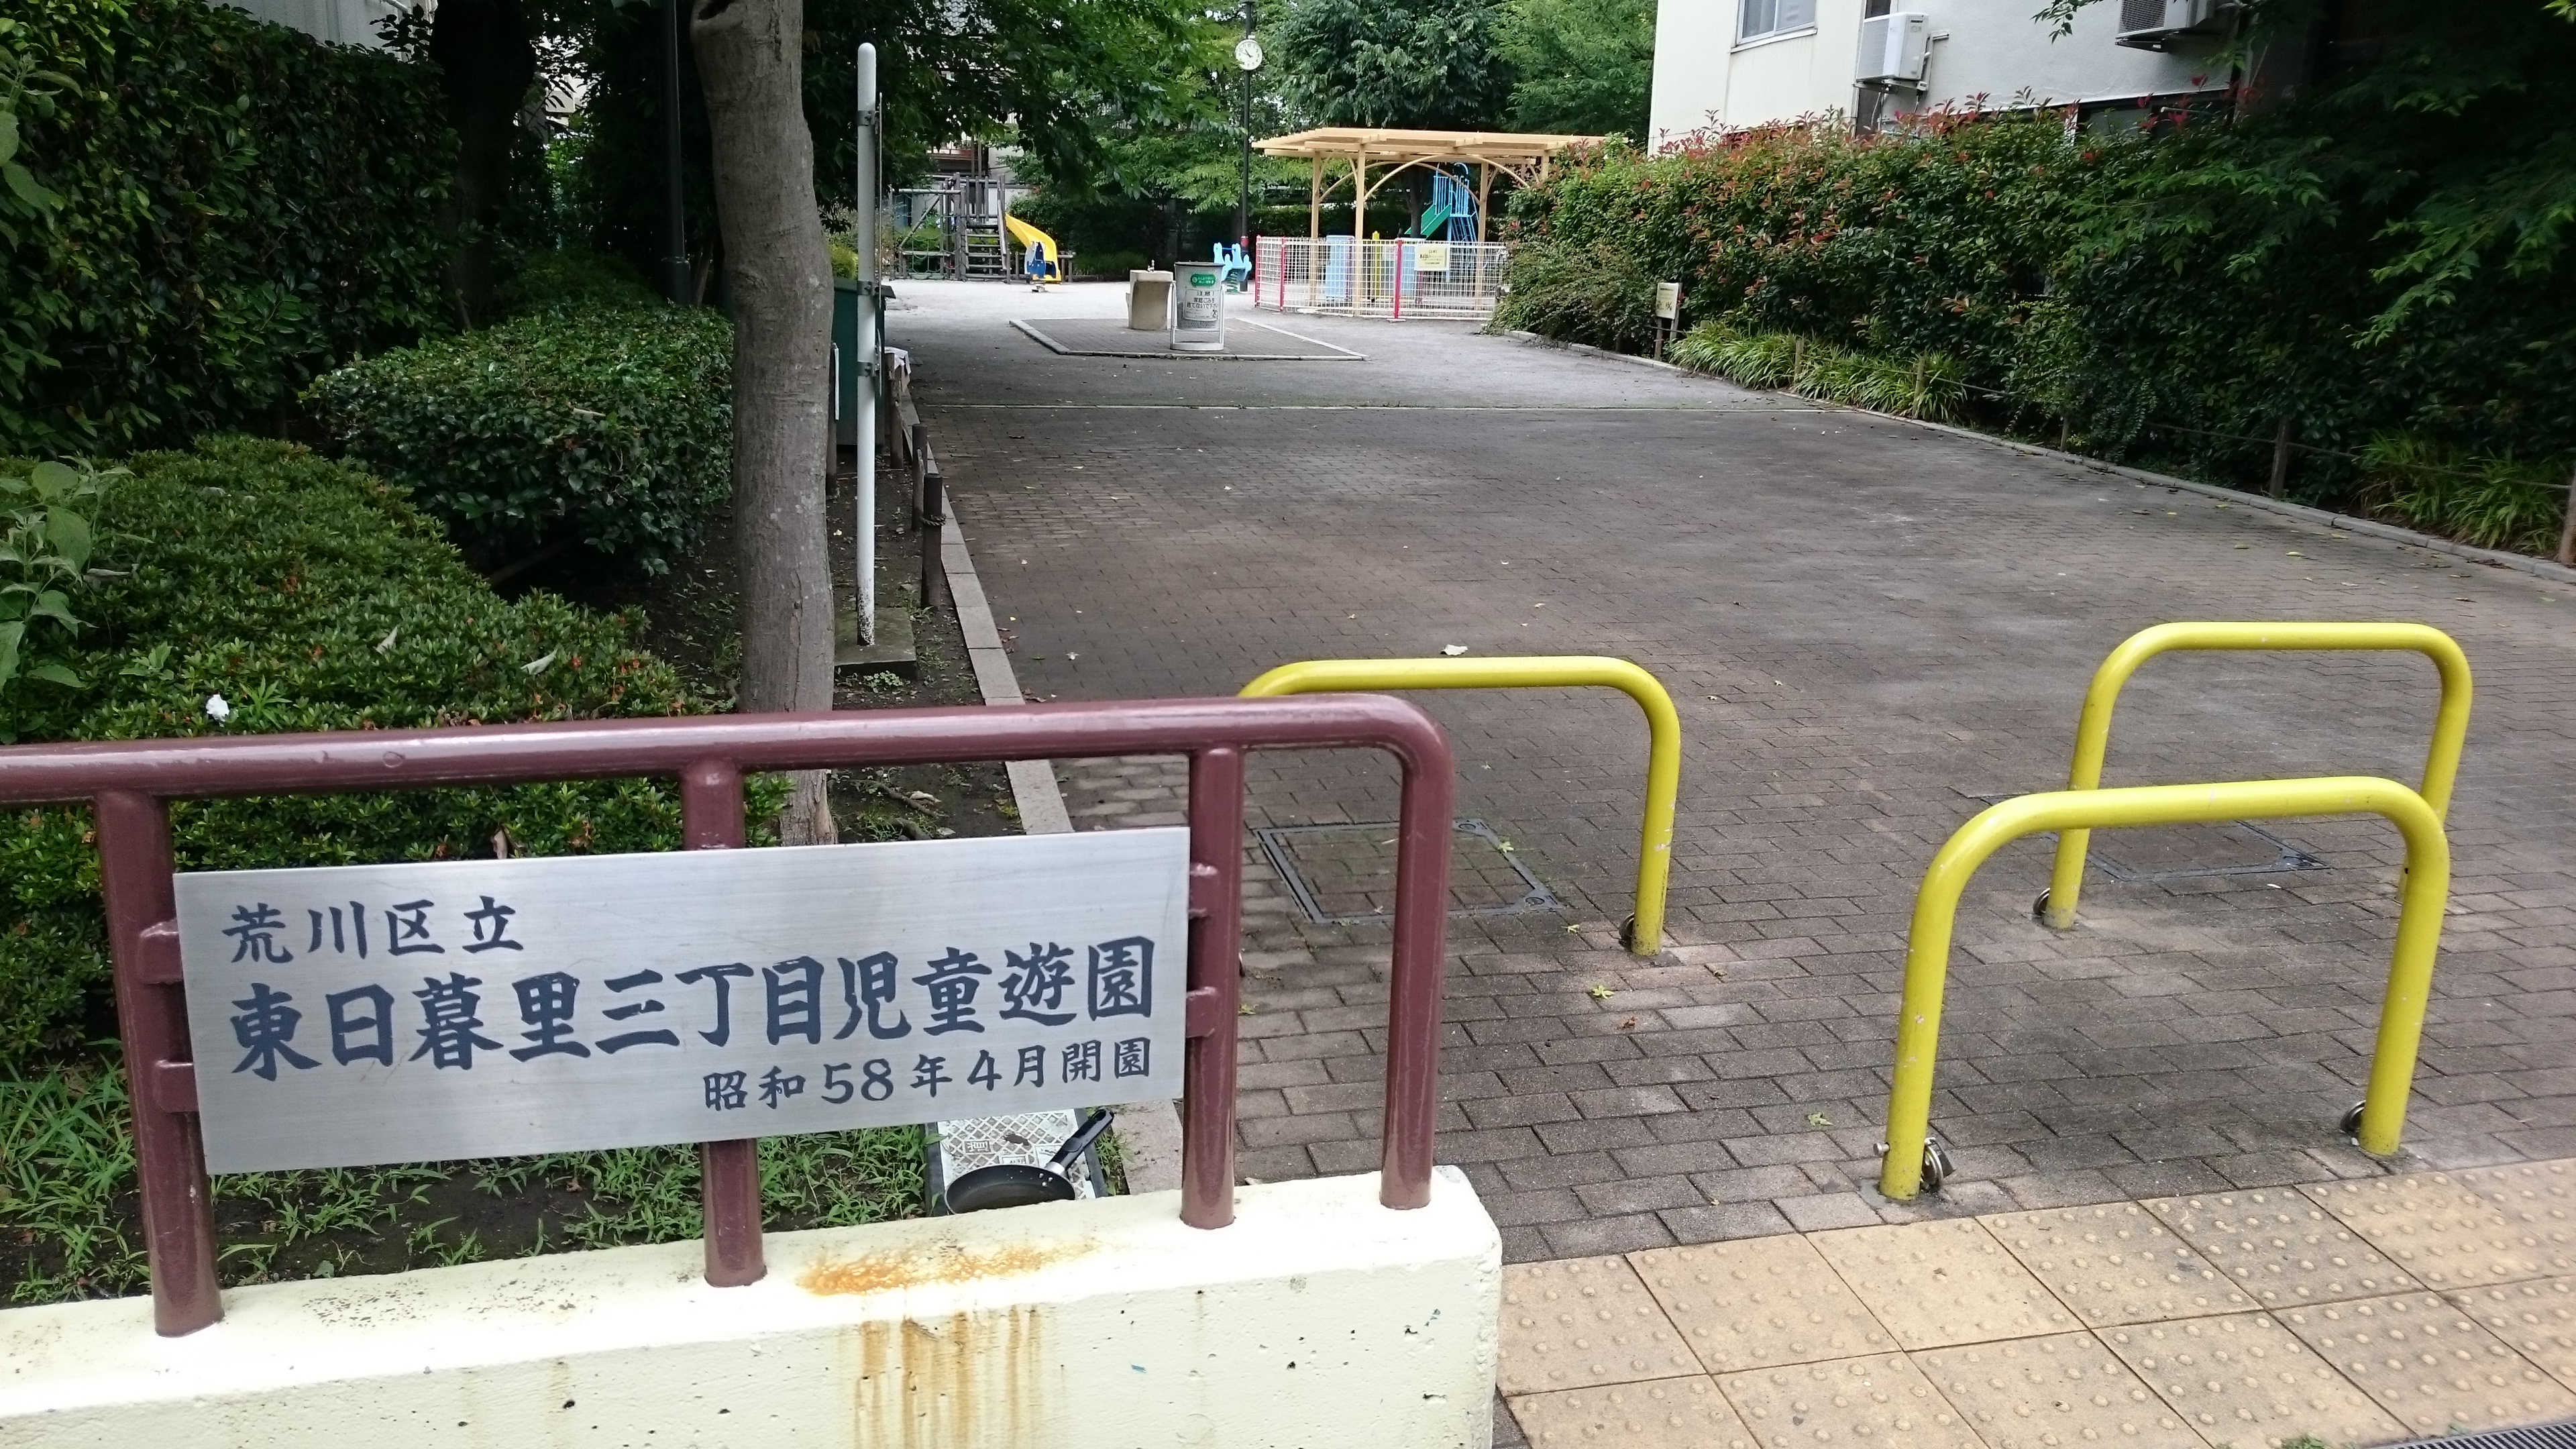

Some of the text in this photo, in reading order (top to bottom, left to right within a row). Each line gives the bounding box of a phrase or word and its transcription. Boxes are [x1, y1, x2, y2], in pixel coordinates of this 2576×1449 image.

[221, 896, 524, 964] 荒川区立
[229, 936, 1155, 1082] 東日暮里三丁目児童遊園
[703, 1036, 1151, 1112] 昭和58年4月開園
